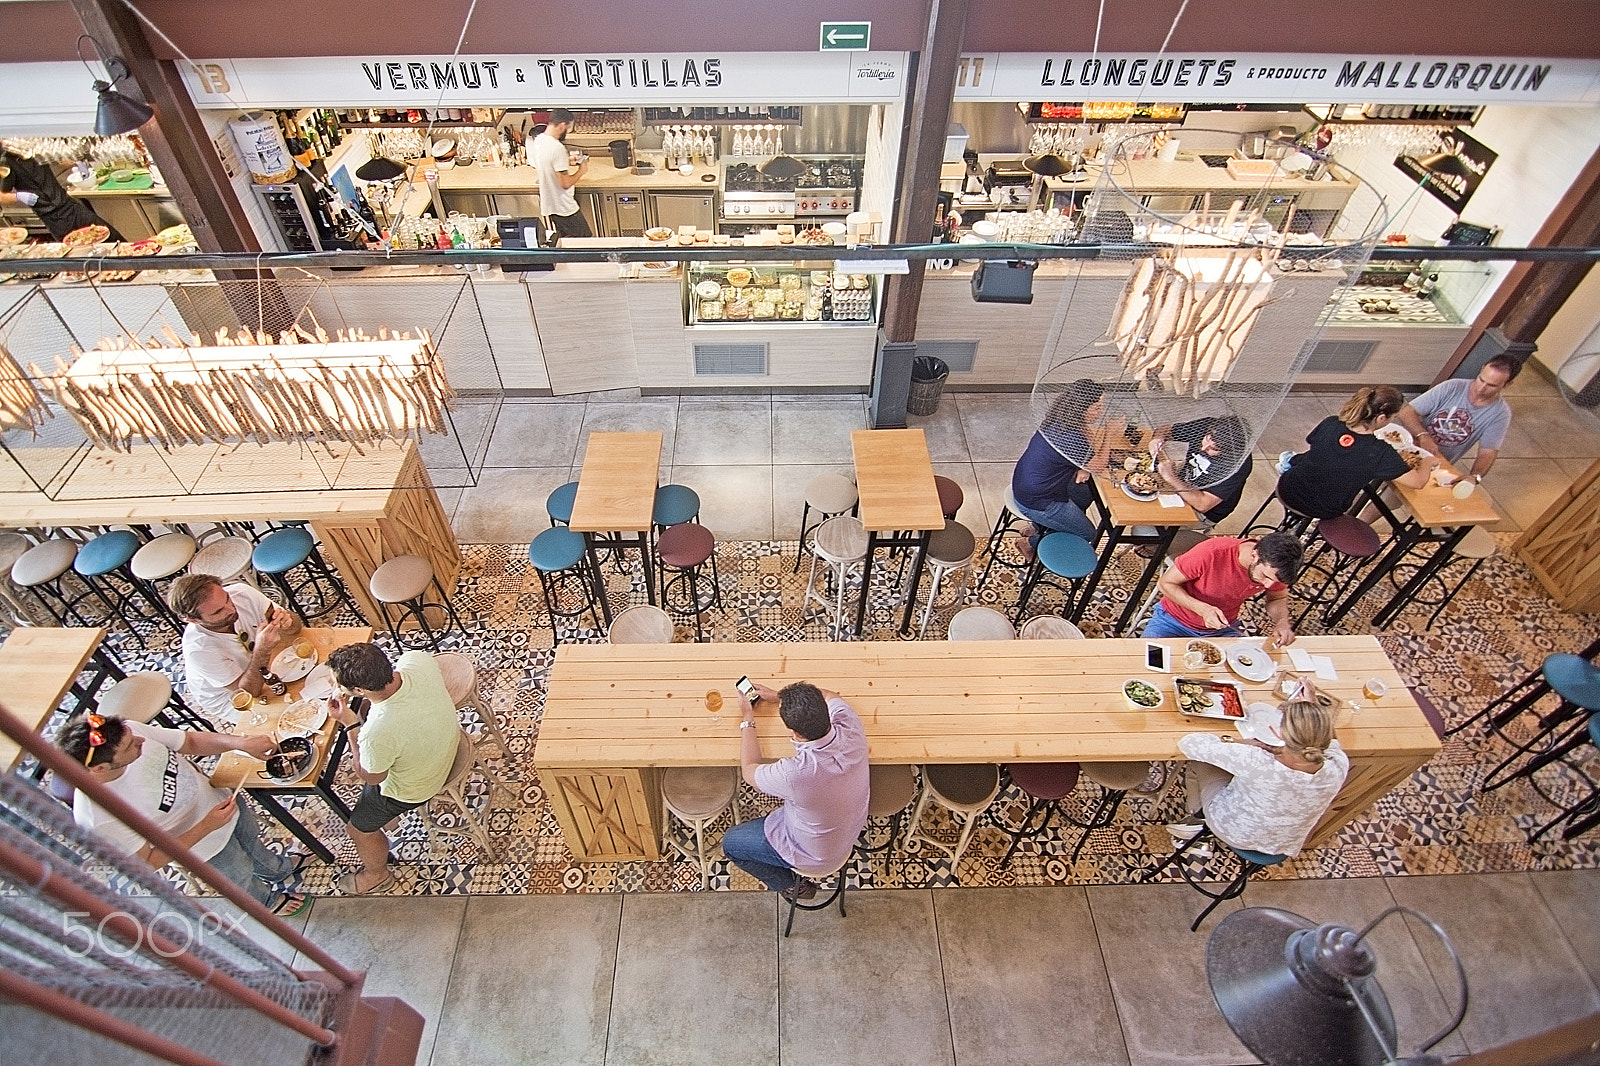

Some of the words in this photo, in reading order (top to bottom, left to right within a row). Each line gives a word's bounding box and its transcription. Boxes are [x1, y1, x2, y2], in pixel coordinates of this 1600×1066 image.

[191, 64, 230, 93] 13
[361, 61, 499, 90] VERMUT
[515, 68, 526, 83] &
[537, 59, 722, 88] TORTILLAS
[959, 57, 984, 87] 11
[1041, 59, 1236, 86] LLONGUETS
[1247, 67, 1255, 79] &
[1257, 68, 1327, 80] PRODUCTO
[1335, 61, 1552, 91] MALLORQUIN
[162, 775, 177, 807] RICH
